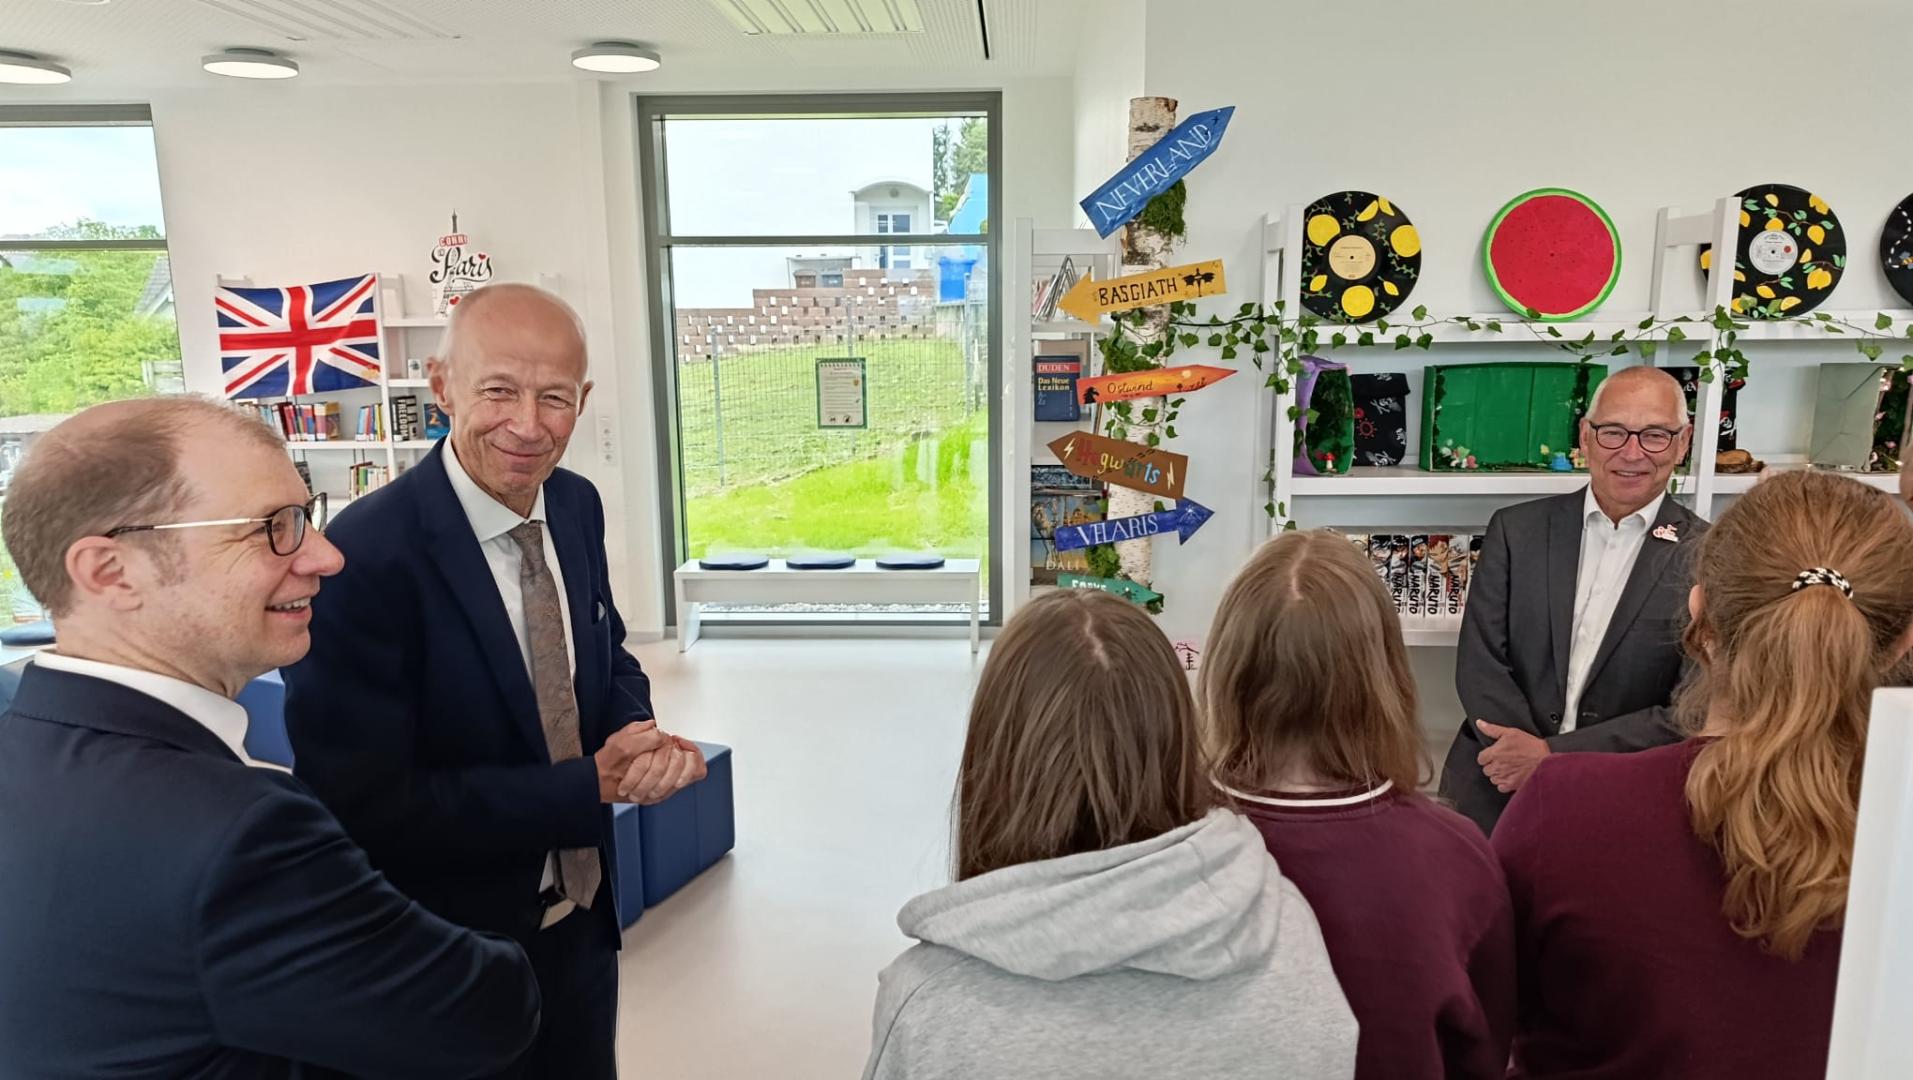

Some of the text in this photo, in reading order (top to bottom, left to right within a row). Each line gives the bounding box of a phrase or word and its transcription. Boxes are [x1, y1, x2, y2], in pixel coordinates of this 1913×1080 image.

[1096, 124, 1212, 223] NEVERLAND
[430, 245, 493, 283] Paris
[1098, 277, 1178, 306] BASGIATH
[1038, 364, 1070, 372] DUDEN
[1107, 381, 1153, 394] Ostwind
[397, 399, 409, 438] FREEDOM
[1077, 438, 1161, 484] Hogwarts
[1076, 514, 1159, 546] VELARIS
[1408, 574, 1421, 615] NARUTO
[1426, 574, 1440, 615] NARUTO
[1447, 574, 1460, 615] NARUTO
